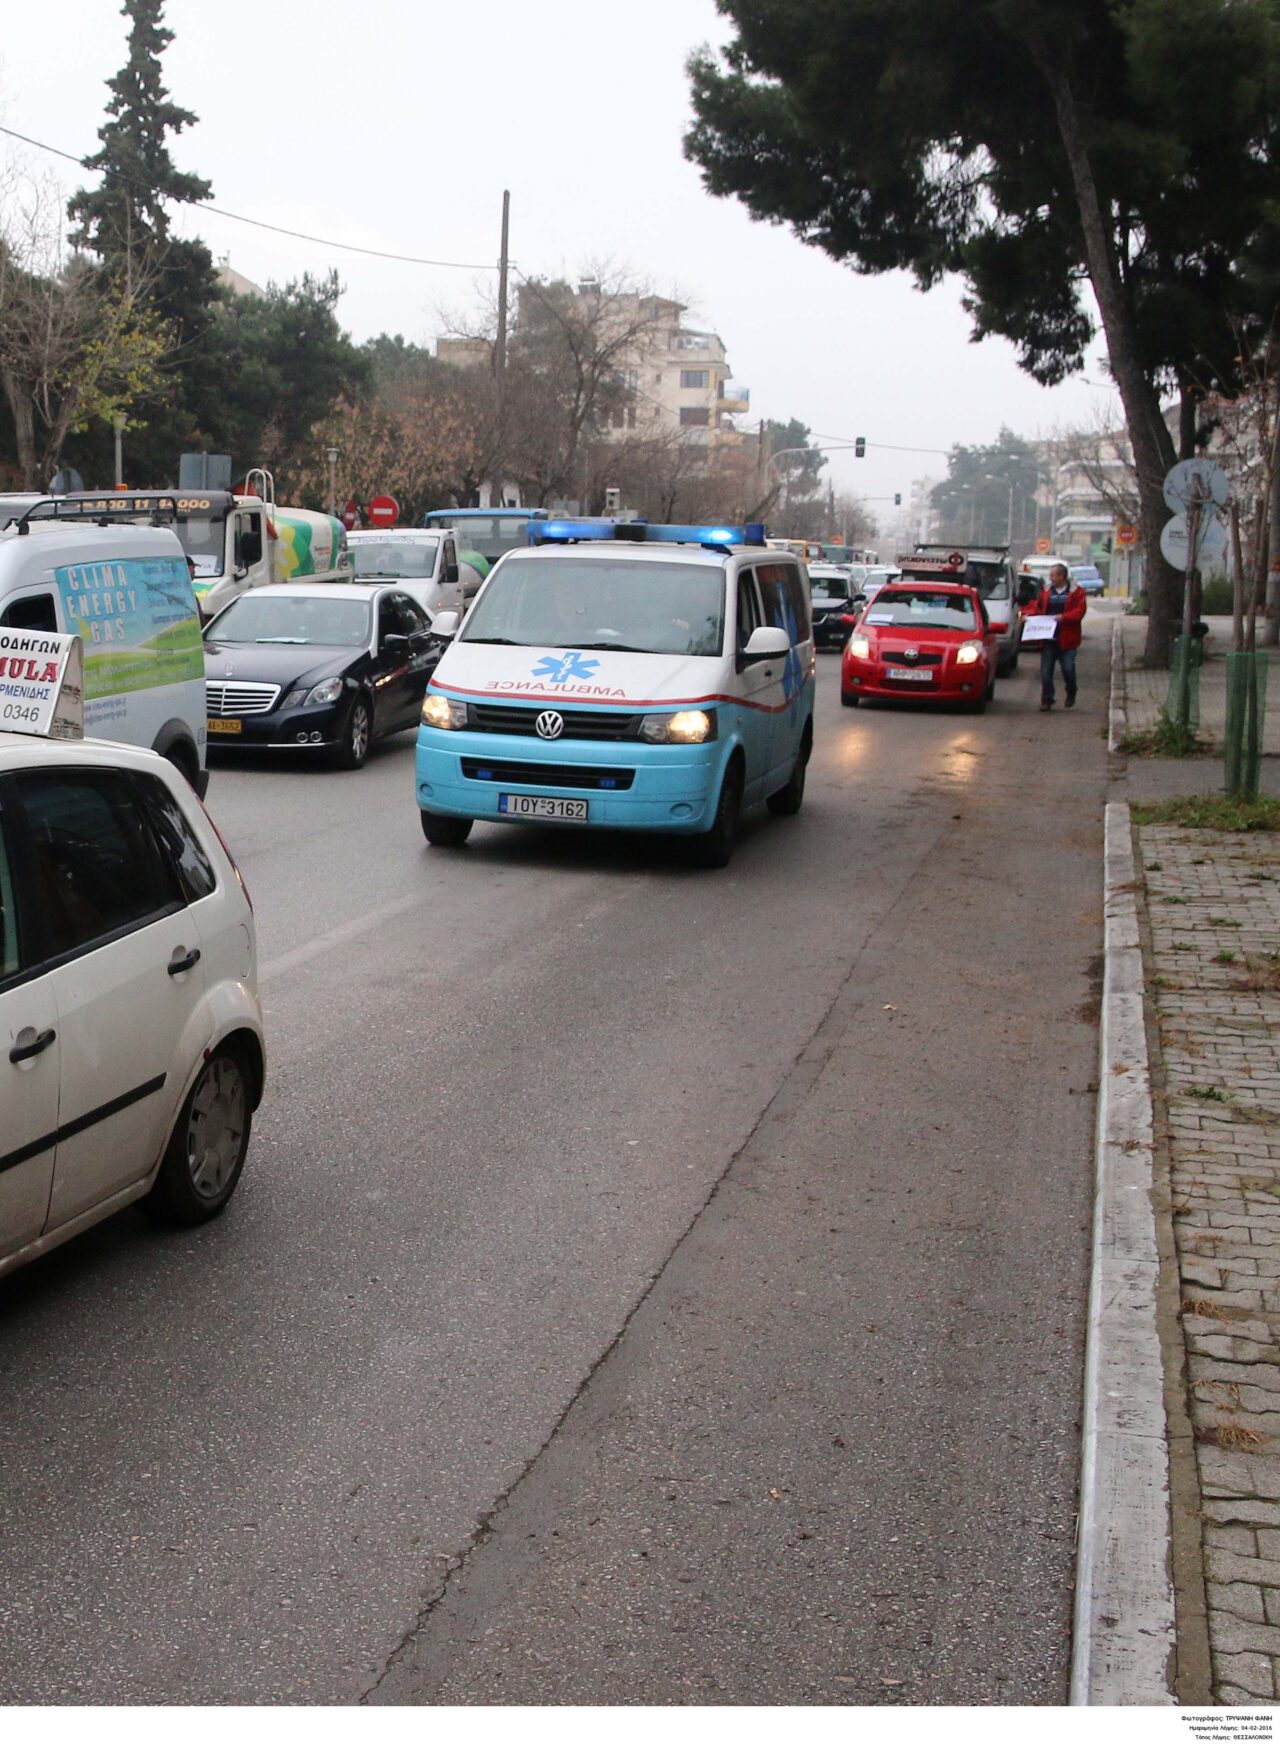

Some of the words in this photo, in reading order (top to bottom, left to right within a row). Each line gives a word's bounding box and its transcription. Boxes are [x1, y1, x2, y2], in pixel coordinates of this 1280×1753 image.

[67, 565, 128, 591] CLIMA
[66, 590, 137, 619] ENERGY
[90, 618, 125, 643] GAS
[0, 636, 61, 654] ΟΔΗΓΩΝ
[3, 705, 40, 722] 0346
